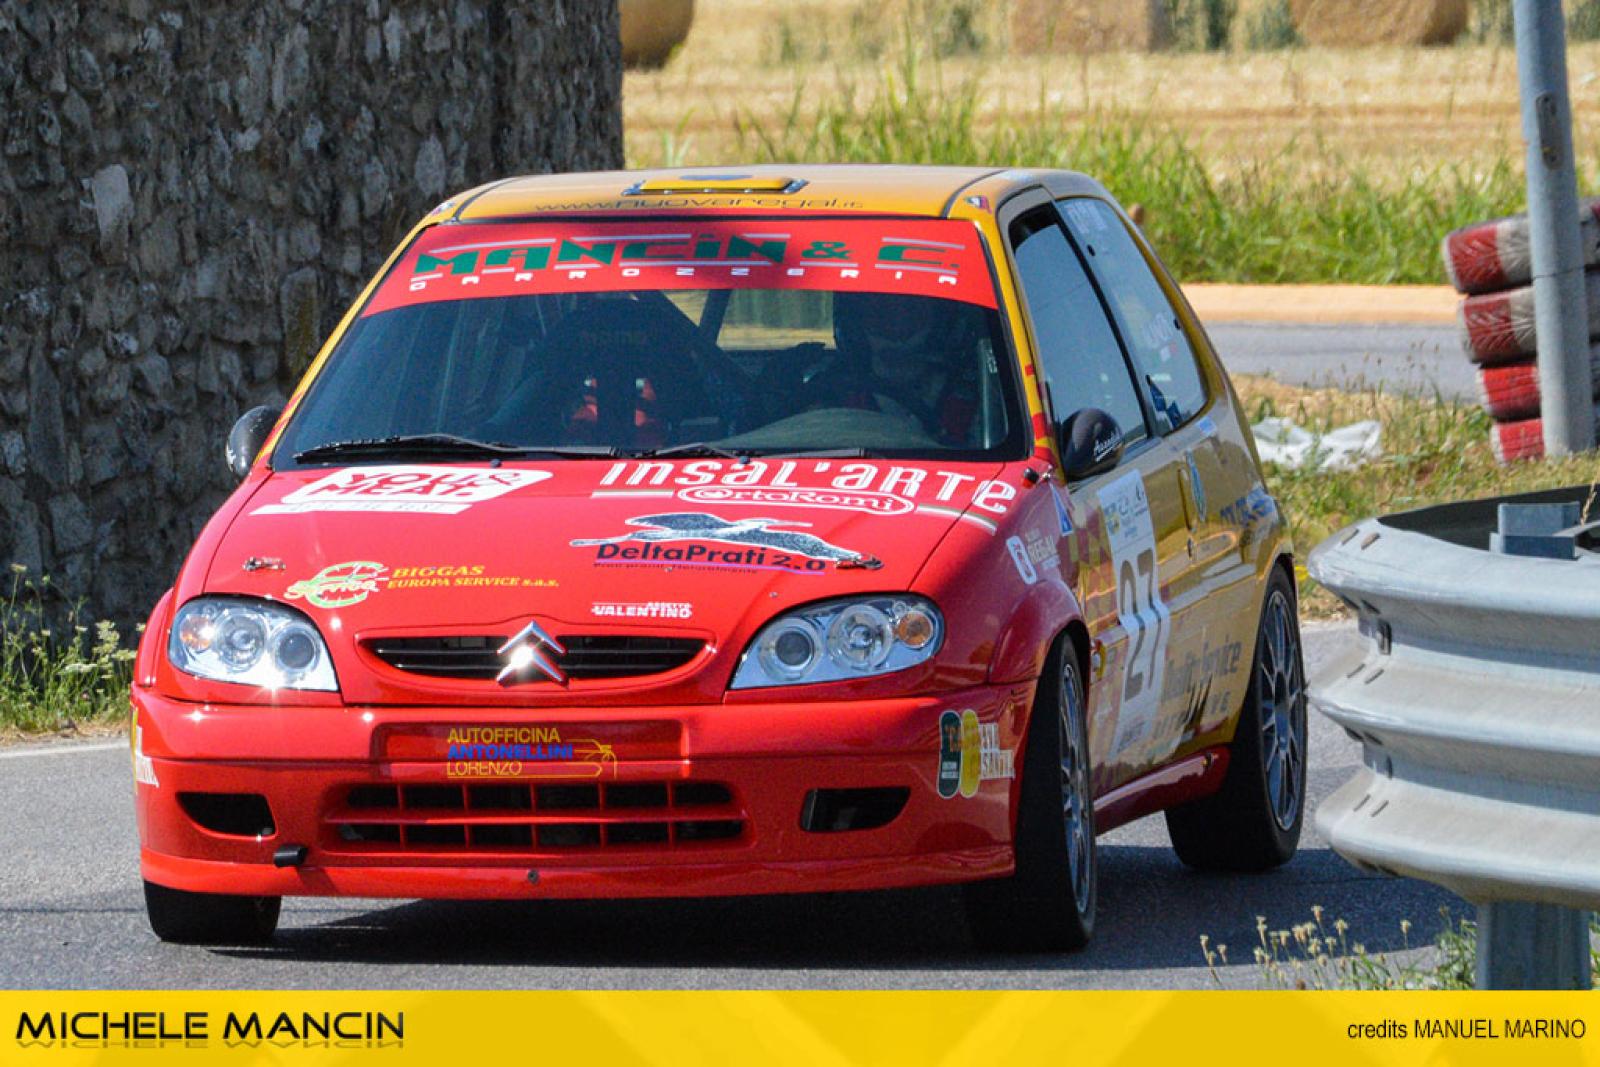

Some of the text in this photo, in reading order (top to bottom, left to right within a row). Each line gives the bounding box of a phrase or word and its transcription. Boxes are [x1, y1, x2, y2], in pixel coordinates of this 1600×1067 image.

[801, 241, 856, 259] &
[596, 542, 827, 572] DeltaPrati 2.0
[392, 565, 485, 578] BIGGAS
[387, 577, 451, 589] EUROPA
[453, 576, 520, 587] SERVICE
[591, 604, 692, 619] VALENTINO
[1119, 548, 1162, 702] 27
[447, 727, 560, 743] AUTOFFICINA
[447, 744, 573, 759] ANTONELLINI
[447, 761, 522, 776] LORENZO
